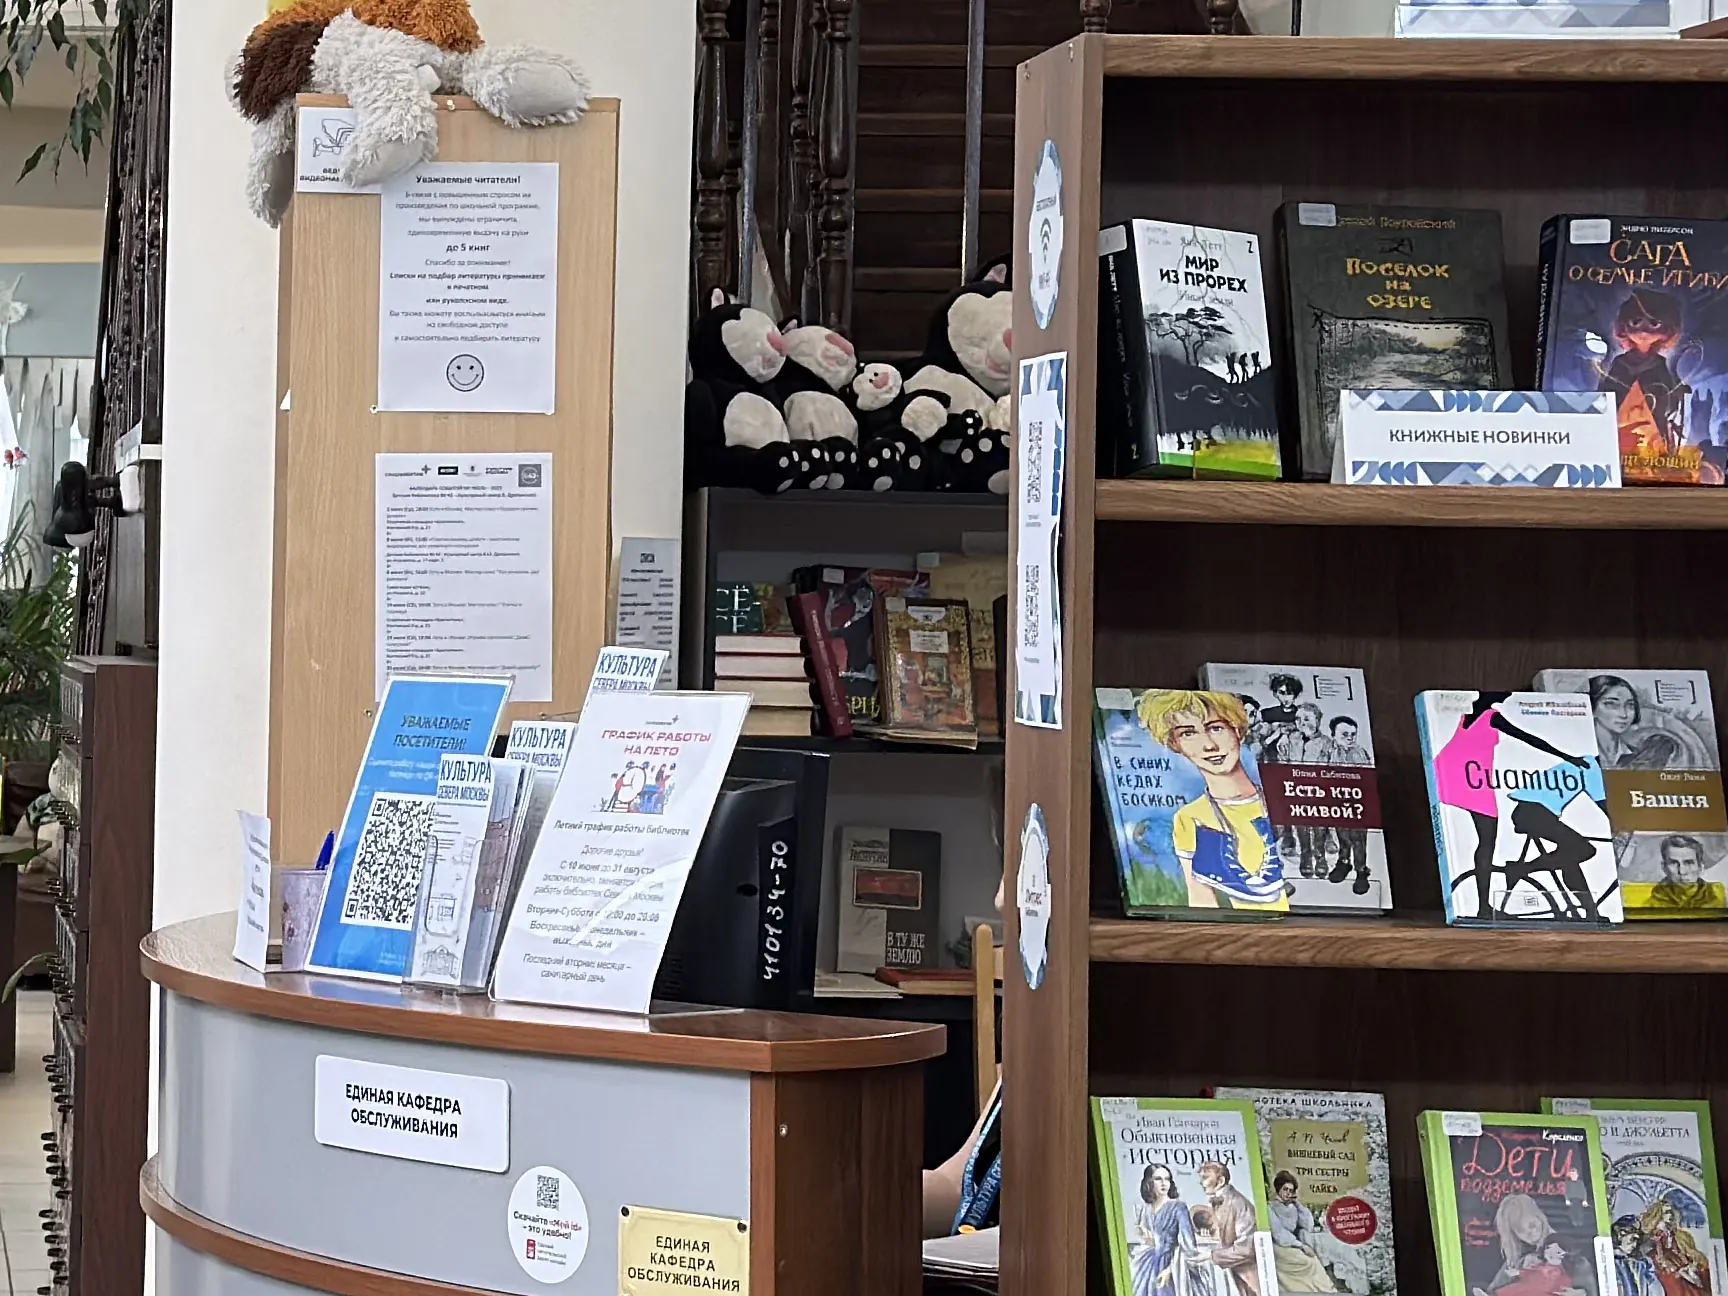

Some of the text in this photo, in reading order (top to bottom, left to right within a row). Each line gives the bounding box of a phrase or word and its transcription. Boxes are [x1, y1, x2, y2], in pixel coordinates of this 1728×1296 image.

[1185, 254, 1220, 272] МИР
[1159, 267, 1248, 294] ИЗ ПРОРЕХ
[1389, 428, 1572, 446] КНИЖНЫЕ НОВИНКИ
[596, 652, 659, 678] КУЛЬТУРА
[400, 714, 472, 732] УВАЖАЕМЫЕ
[393, 733, 468, 751] ПОСЕТИТЕЛИ!
[510, 726, 567, 750] КУЛЬТУРА
[601, 729, 712, 743] ГРАФИК РАБОТЫ
[623, 744, 680, 756] НА ЛЕТО
[439, 759, 492, 785] КУЛЬТУРА
[1130, 756, 1173, 773] СИНИХ
[1116, 772, 1164, 790] КЕДАХ
[1283, 780, 1364, 801] Есть кто
[1121, 792, 1189, 809] БОСИКОМ
[1630, 790, 1710, 810] Башня
[1289, 801, 1365, 822] живой?
[909, 933, 925, 948] ЖЕ
[887, 949, 922, 965] ЗЕМЛЮ
[344, 1081, 462, 1116] ЕДИНАЯ КАФЕДРА
[350, 1108, 459, 1139] ОБСЛУЖИВАНИЯ
[1120, 1127, 1237, 1146] Обыкновенная
[1295, 1166, 1351, 1179] ТРИ СЕСТРЫ
[1308, 1181, 1339, 1195] ЧАЙКА
[655, 1235, 711, 1254] ЕДИНАЯ
[649, 1252, 716, 1272] КАФЕДРА
[627, 1266, 741, 1293] ОБСЛУЖИВАНИЯ
